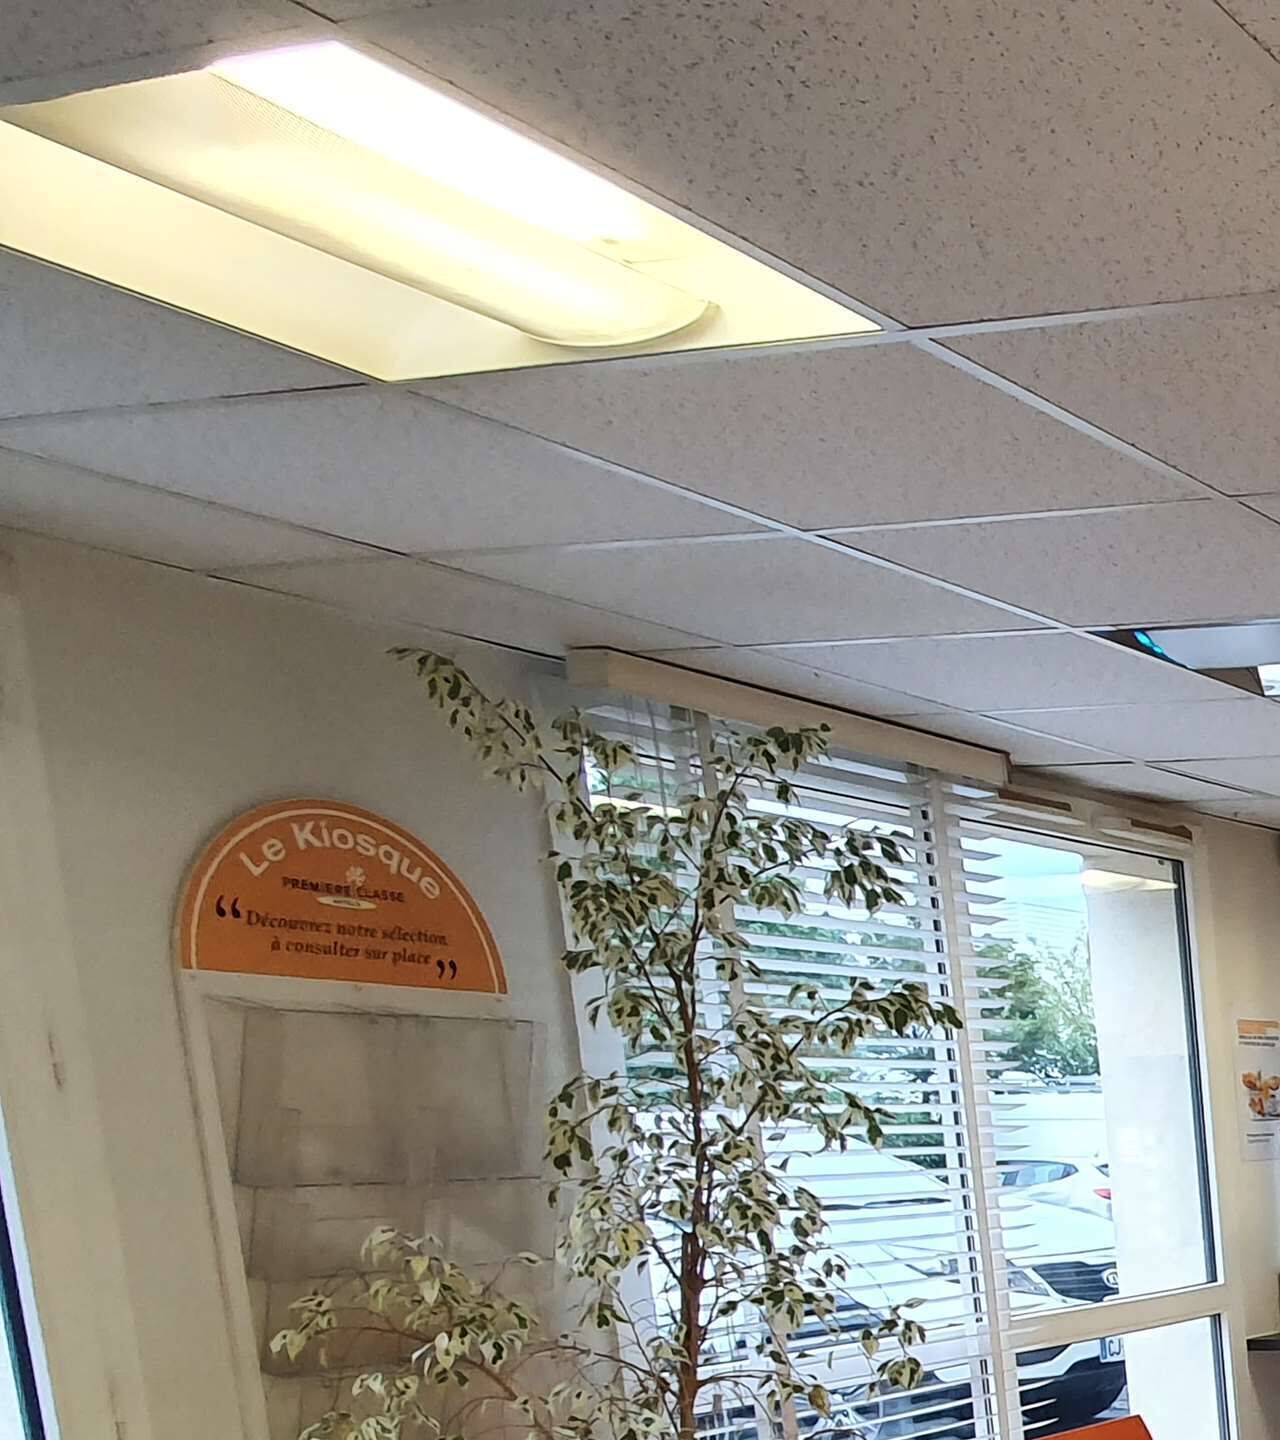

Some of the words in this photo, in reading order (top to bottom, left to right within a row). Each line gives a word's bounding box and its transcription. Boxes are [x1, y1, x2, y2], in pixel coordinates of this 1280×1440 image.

[239, 837, 286, 878] Le
[290, 819, 441, 899] Kiosque
[355, 886, 406, 904] CLASSE
[335, 920, 378, 939] notre
[270, 935, 282, 953] à
[284, 939, 360, 959] consulter
[364, 946, 389, 961] sur
[391, 947, 433, 966] place
